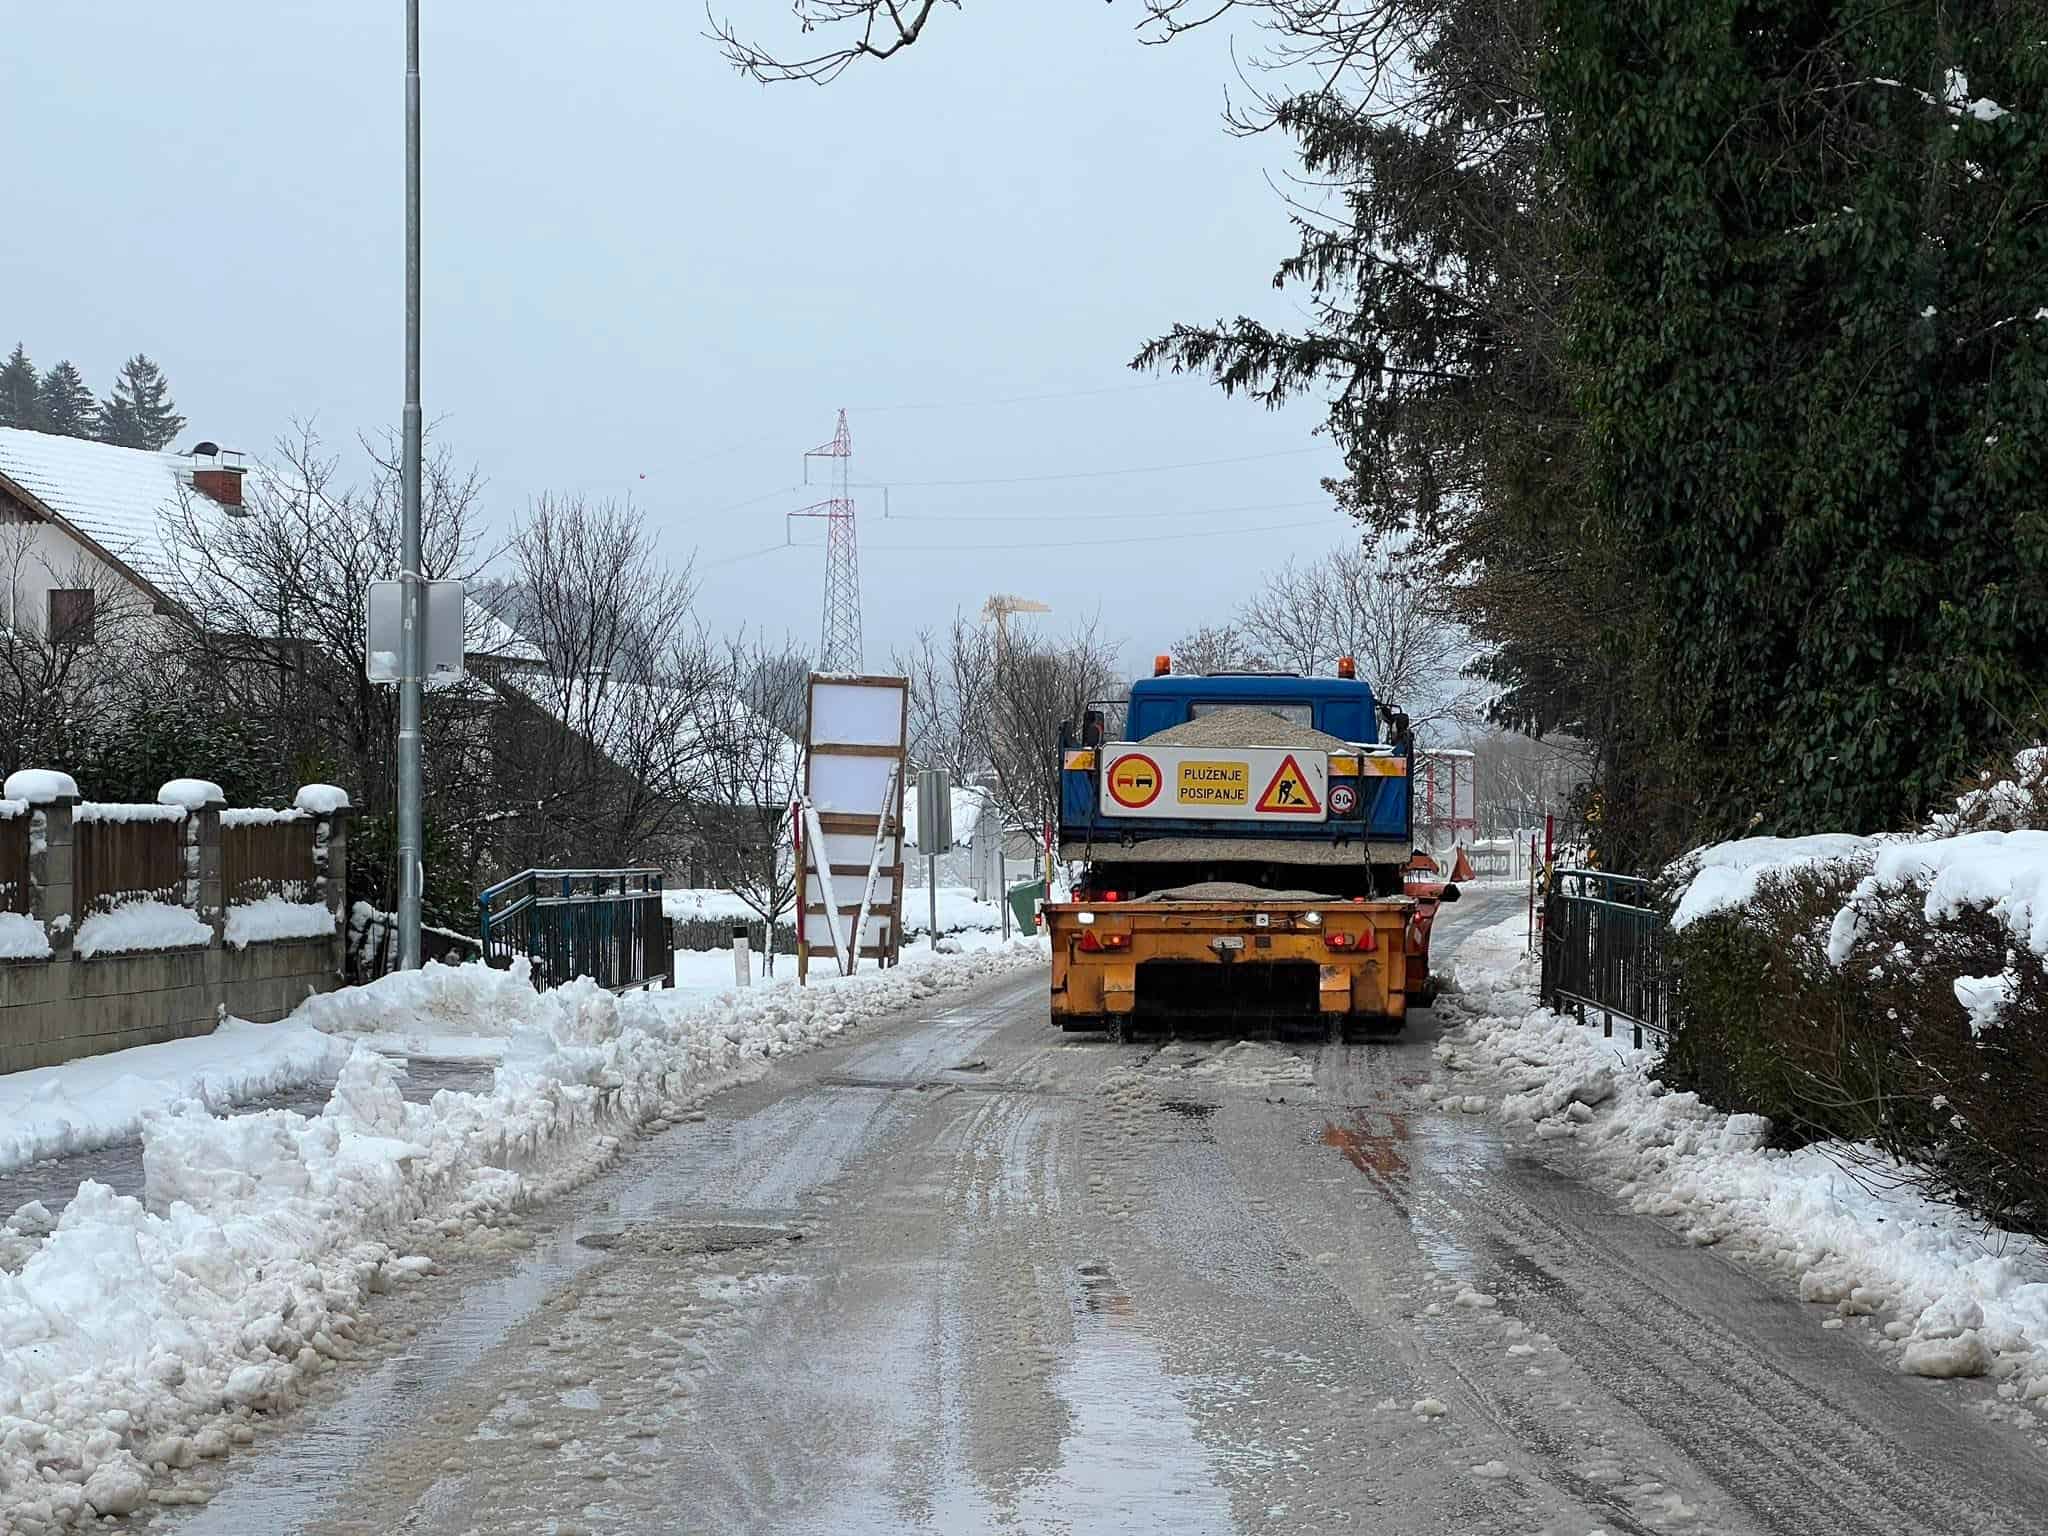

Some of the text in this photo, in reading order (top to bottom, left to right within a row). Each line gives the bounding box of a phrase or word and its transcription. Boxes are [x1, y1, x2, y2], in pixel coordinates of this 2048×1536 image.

[1184, 766, 1242, 781] PLUŽENJE
[1180, 787, 1245, 800] POSIPANJE
[1334, 793, 1349, 805] 90
